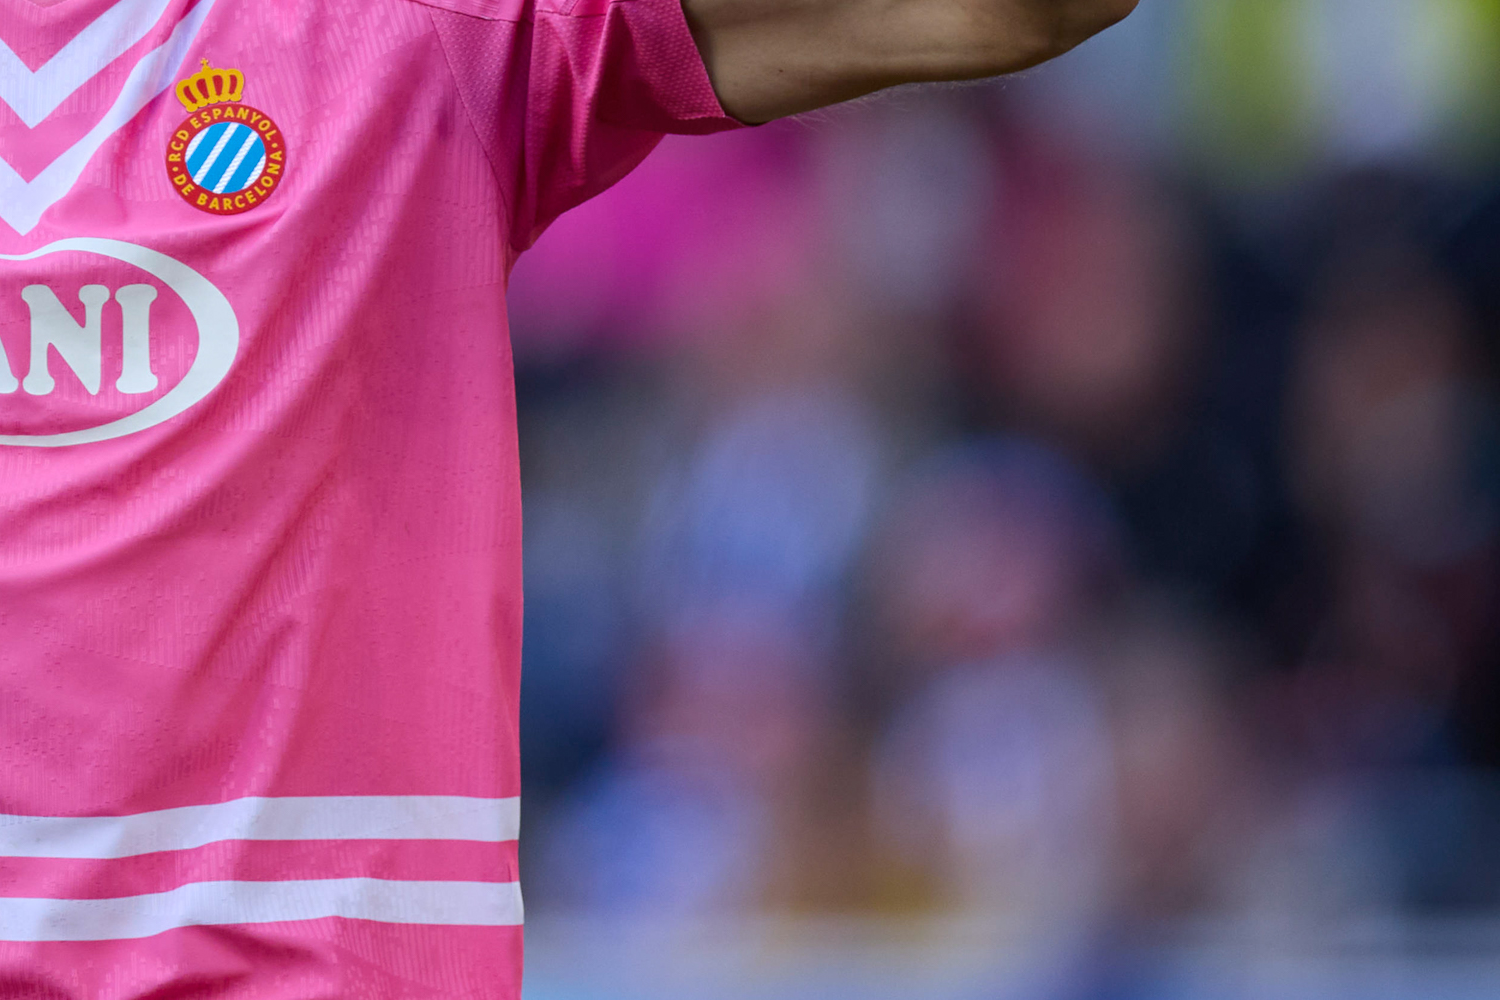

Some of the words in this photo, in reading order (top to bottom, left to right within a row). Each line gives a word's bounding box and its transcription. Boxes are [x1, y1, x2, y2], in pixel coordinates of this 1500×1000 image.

[168, 130, 189, 162] RCD
[190, 106, 277, 141] ESPANYOL
[173, 173, 195, 196] DE
[197, 150, 283, 211] BARCELONA
